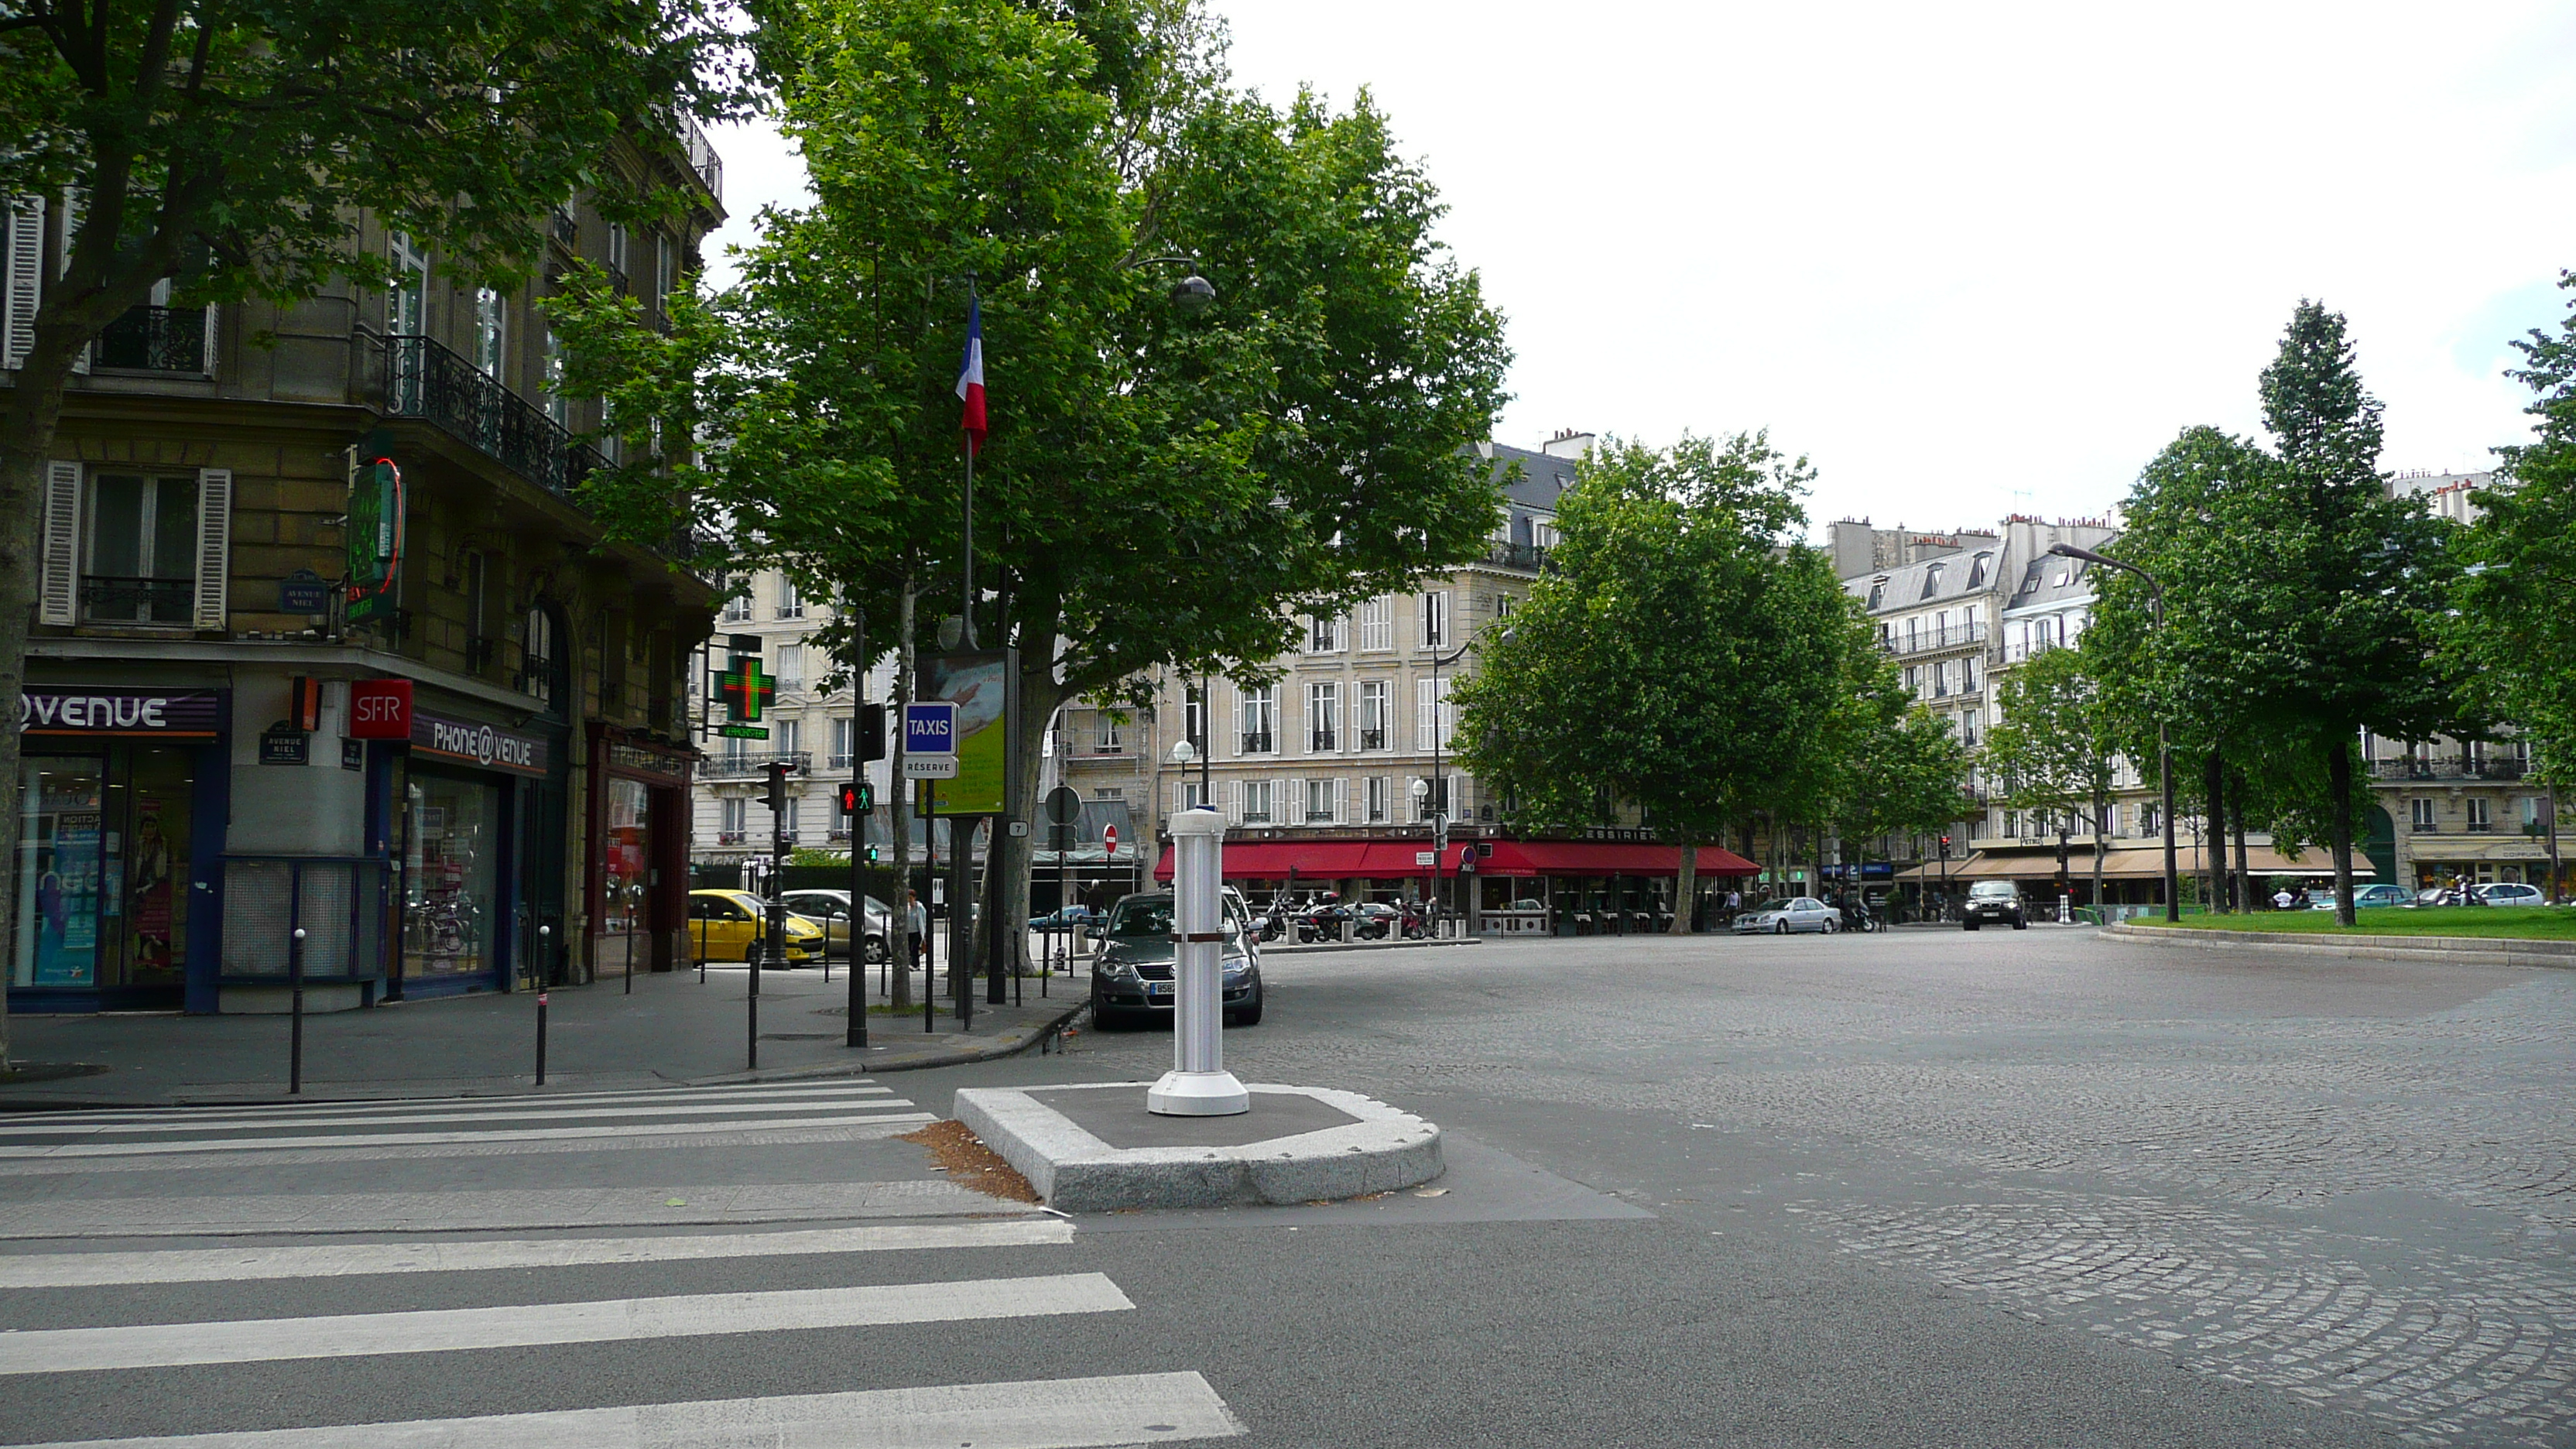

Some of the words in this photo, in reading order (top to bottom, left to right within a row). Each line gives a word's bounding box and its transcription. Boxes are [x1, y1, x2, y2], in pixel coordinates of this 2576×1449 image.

[287, 590, 320, 598] AVENUE
[293, 598, 313, 607] NIEL
[21, 693, 167, 733] VENUE
[356, 696, 401, 721] SFR
[909, 719, 949, 735] TAXIS
[268, 737, 302, 745] AVENUE
[273, 745, 295, 753] NIEL
[907, 762, 951, 772] RÉSERVE
[1577, 829, 1657, 841] ESSIRIER
